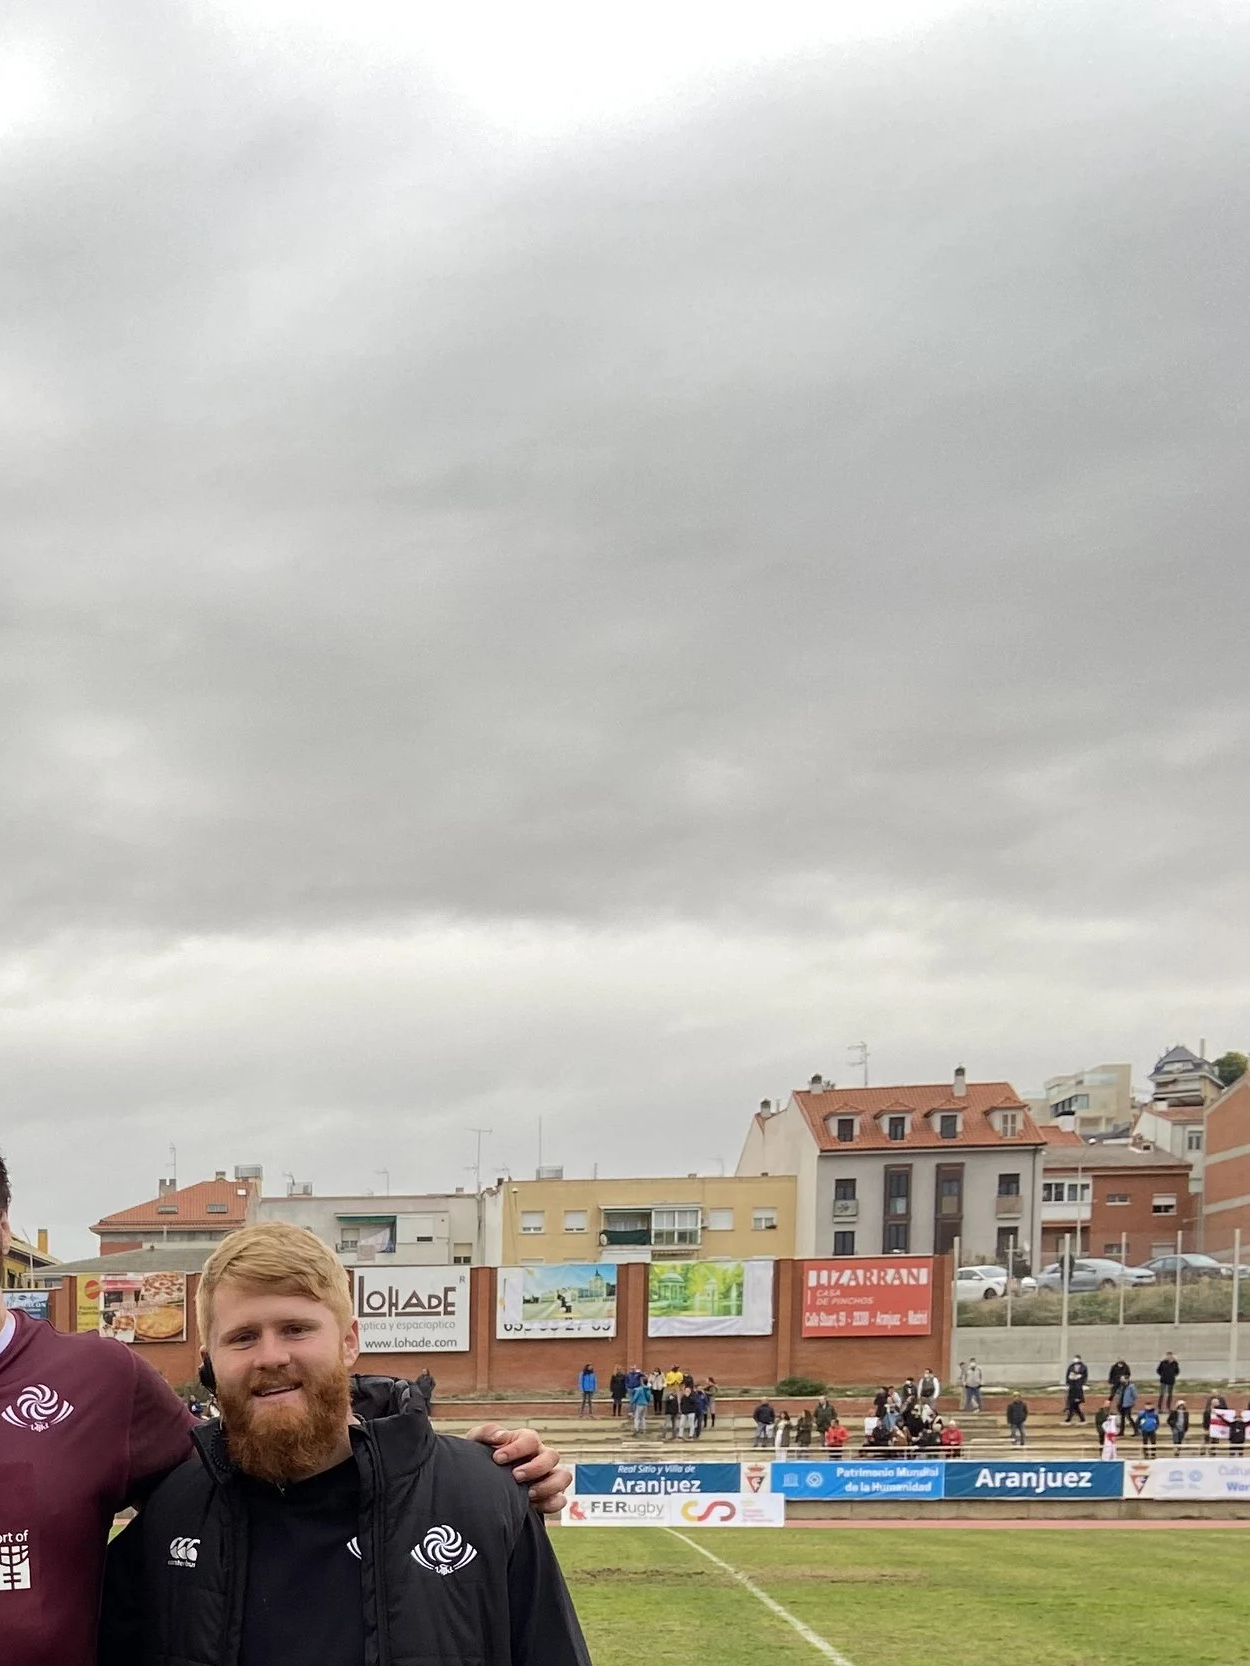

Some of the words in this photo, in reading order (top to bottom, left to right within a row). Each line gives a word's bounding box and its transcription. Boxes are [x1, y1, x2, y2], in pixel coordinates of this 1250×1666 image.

[808, 1268, 928, 1287] LIZARRAN
[358, 1275, 456, 1318] LOHADE
[816, 1289, 841, 1298] CASA
[816, 1297, 829, 1306] DE
[831, 1297, 874, 1306] PINCHOS
[365, 1337, 457, 1348] www.lohade.com
[617, 1464, 636, 1474] Real
[638, 1464, 655, 1474] Sitio
[656, 1466, 662, 1475] y
[664, 1464, 683, 1473] Villa
[685, 1464, 696, 1473] de
[836, 1467, 895, 1478] Patrimonio
[896, 1466, 939, 1477] Mundial
[612, 1476, 701, 1494] Aranjuez
[975, 1467, 1093, 1493] Aranjuez
[845, 1483, 857, 1492] de
[860, 1482, 870, 1492] la
[871, 1482, 932, 1493] Humanidad
[591, 1501, 664, 1514] FERugby
[15, 1529, 29, 1543] of
